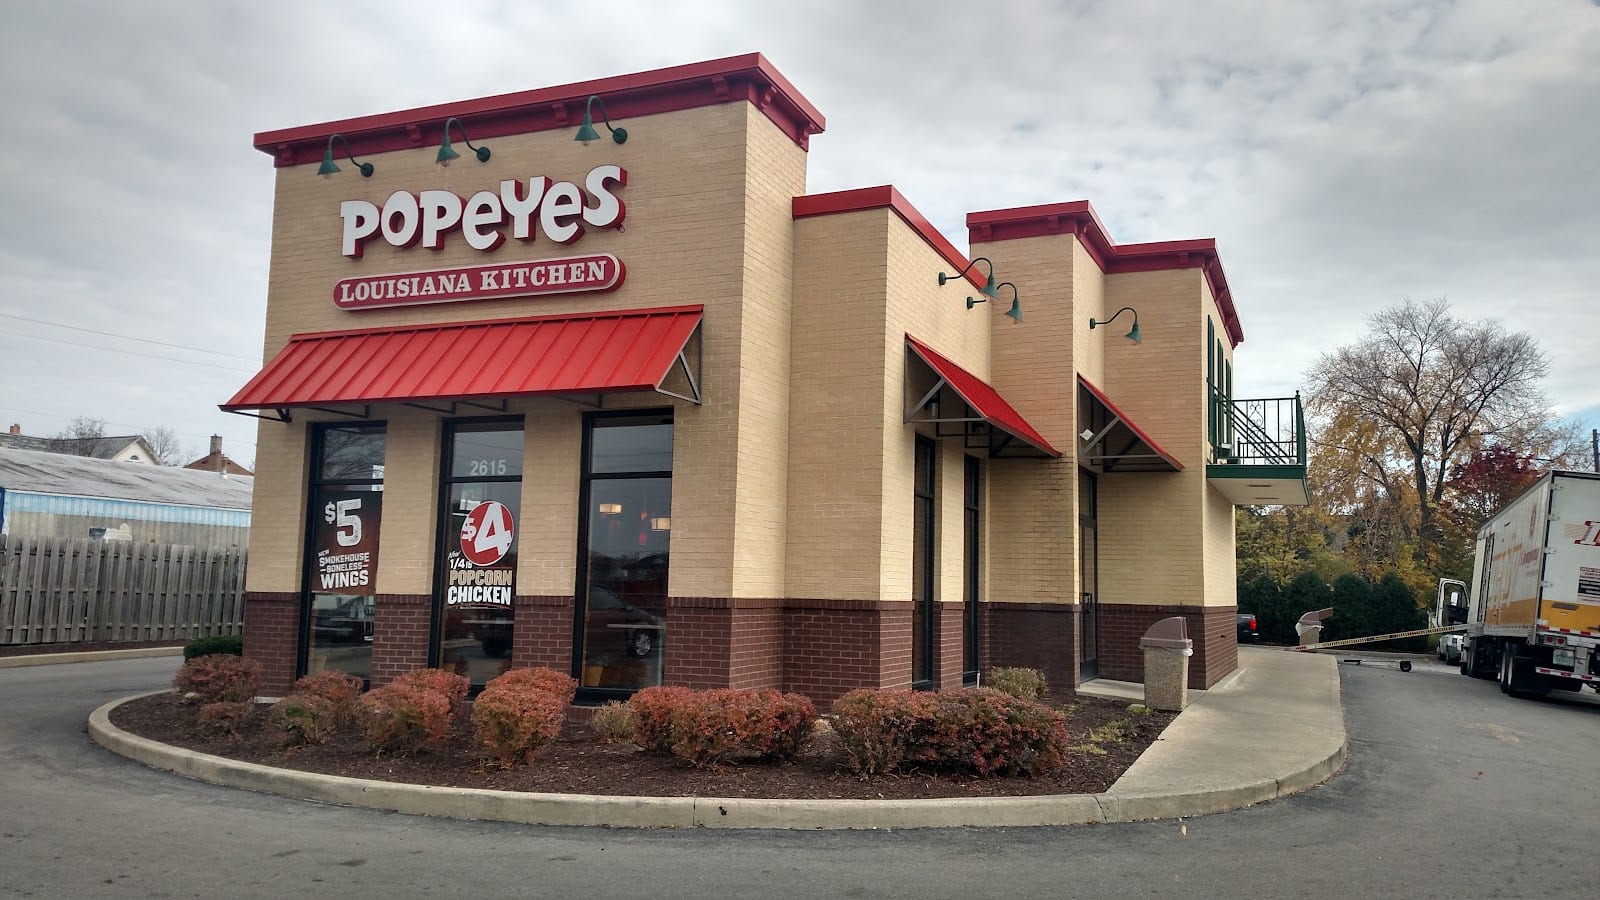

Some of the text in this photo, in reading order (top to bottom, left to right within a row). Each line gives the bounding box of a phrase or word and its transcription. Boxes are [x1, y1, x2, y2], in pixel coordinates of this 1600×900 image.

[340, 260, 607, 303] LOUISIANA KITCHEN
[469, 459, 507, 476] 2615
[324, 498, 362, 547] $5
[461, 501, 513, 556] $4
[319, 552, 370, 567] SMOKEHOUSE
[320, 569, 369, 590] WINGS
[449, 569, 513, 586] POPCORN
[447, 585, 512, 605] CHICKEN
